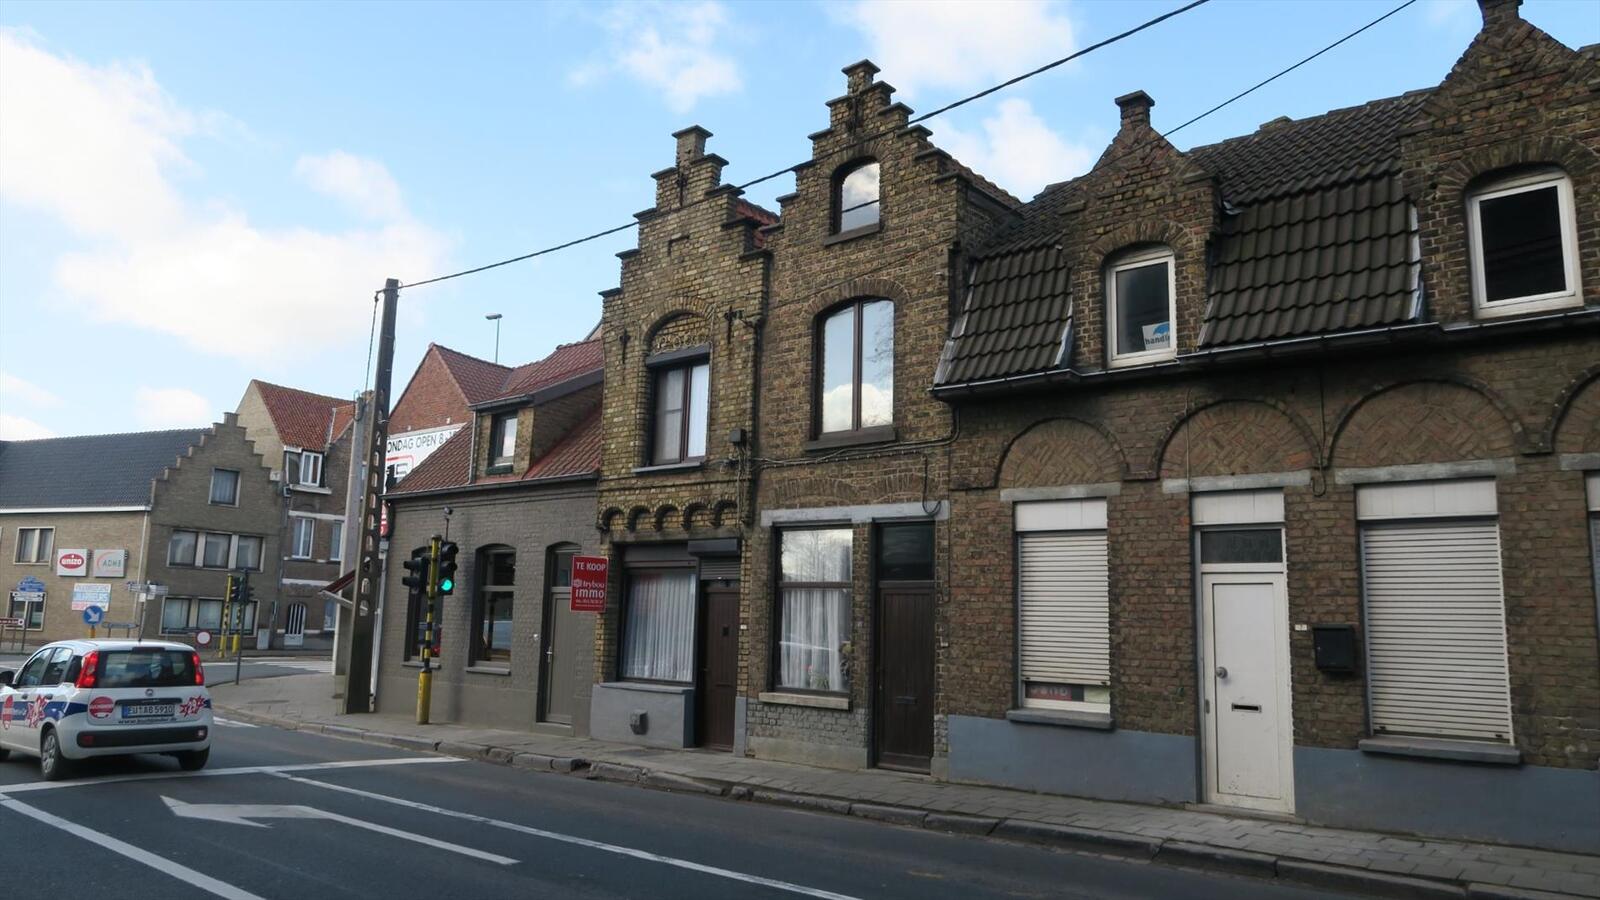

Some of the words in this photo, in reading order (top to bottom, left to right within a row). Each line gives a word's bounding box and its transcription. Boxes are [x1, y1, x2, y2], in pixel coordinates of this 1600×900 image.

[415, 434, 437, 448] OPEN
[61, 554, 82, 565] unizo
[576, 562, 585, 570] TE
[586, 562, 606, 572] KOOP
[576, 588, 604, 599] immo
